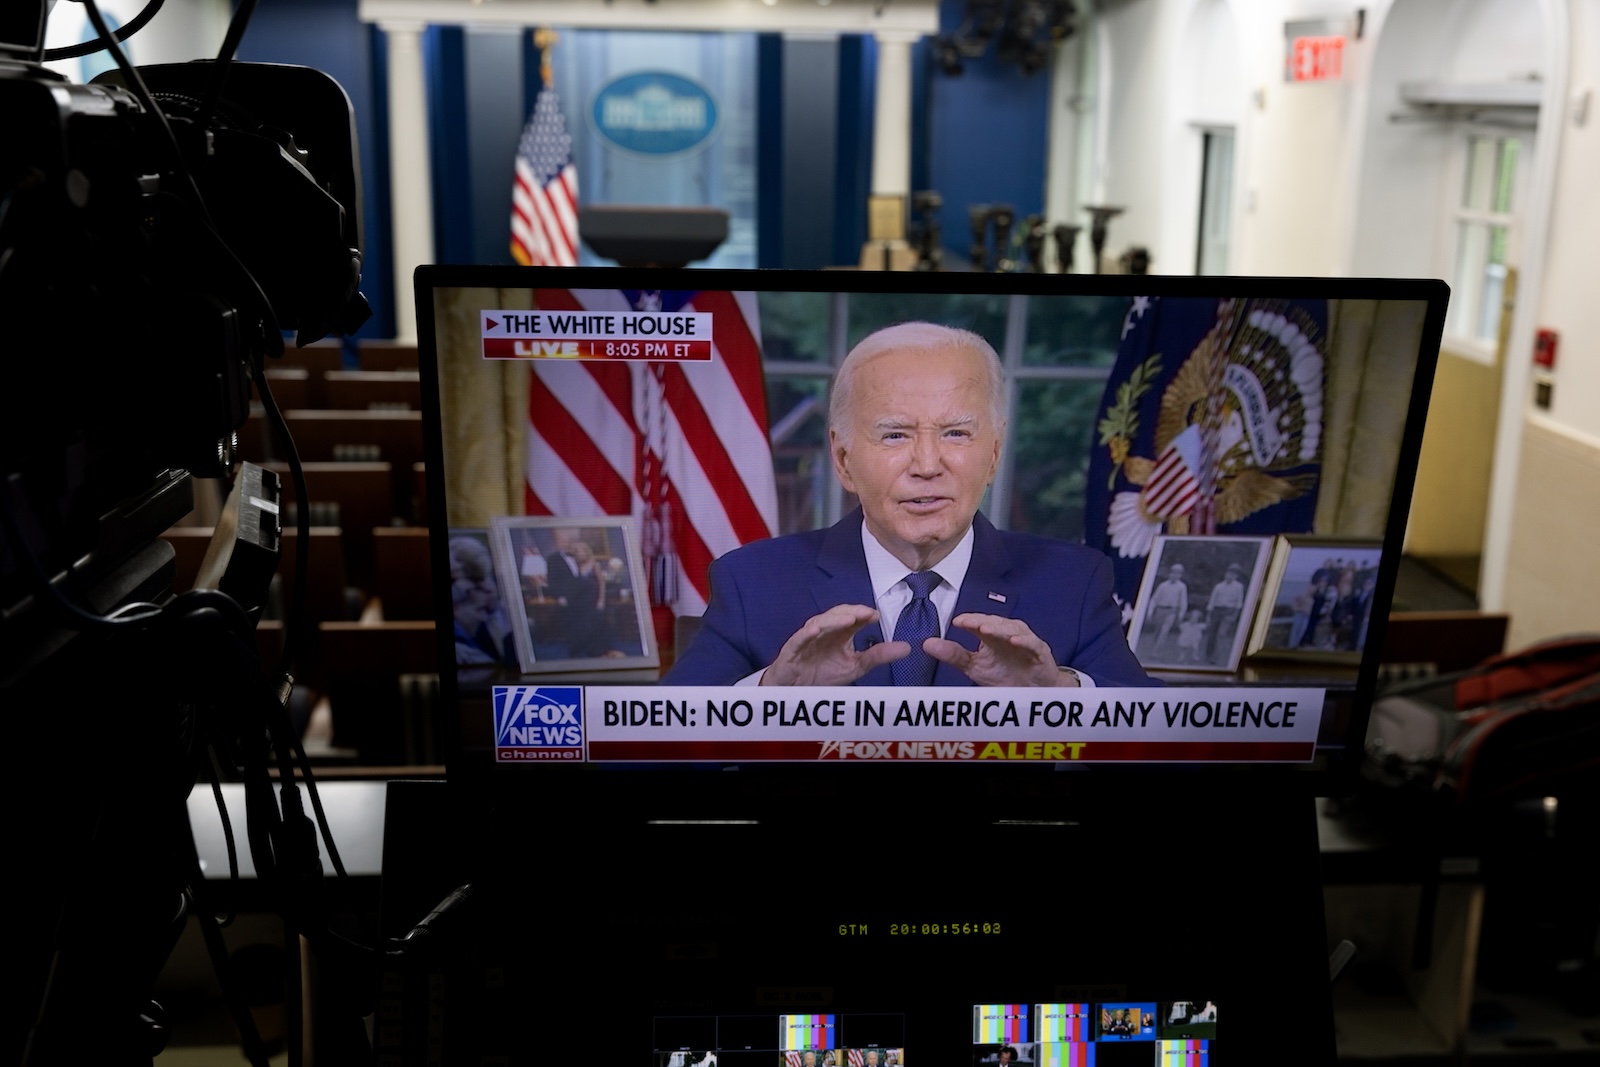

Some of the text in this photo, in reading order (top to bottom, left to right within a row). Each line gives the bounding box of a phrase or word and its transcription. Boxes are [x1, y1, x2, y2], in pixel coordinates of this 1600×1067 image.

[1293, 36, 1346, 81] EXIT
[503, 315, 696, 335] THE WHITE HOUSE
[514, 341, 691, 357] LIVE 8:05 PM ET
[524, 704, 578, 725] FOX
[604, 700, 1298, 728] BIDEN: NO PLACE IN AMERICA FOR ANY VIOLENCE
[510, 727, 581, 745] NEWS
[501, 749, 580, 759] channel
[838, 742, 1086, 760] FOX NEWS ALERT
[838, 924, 868, 936] GTM
